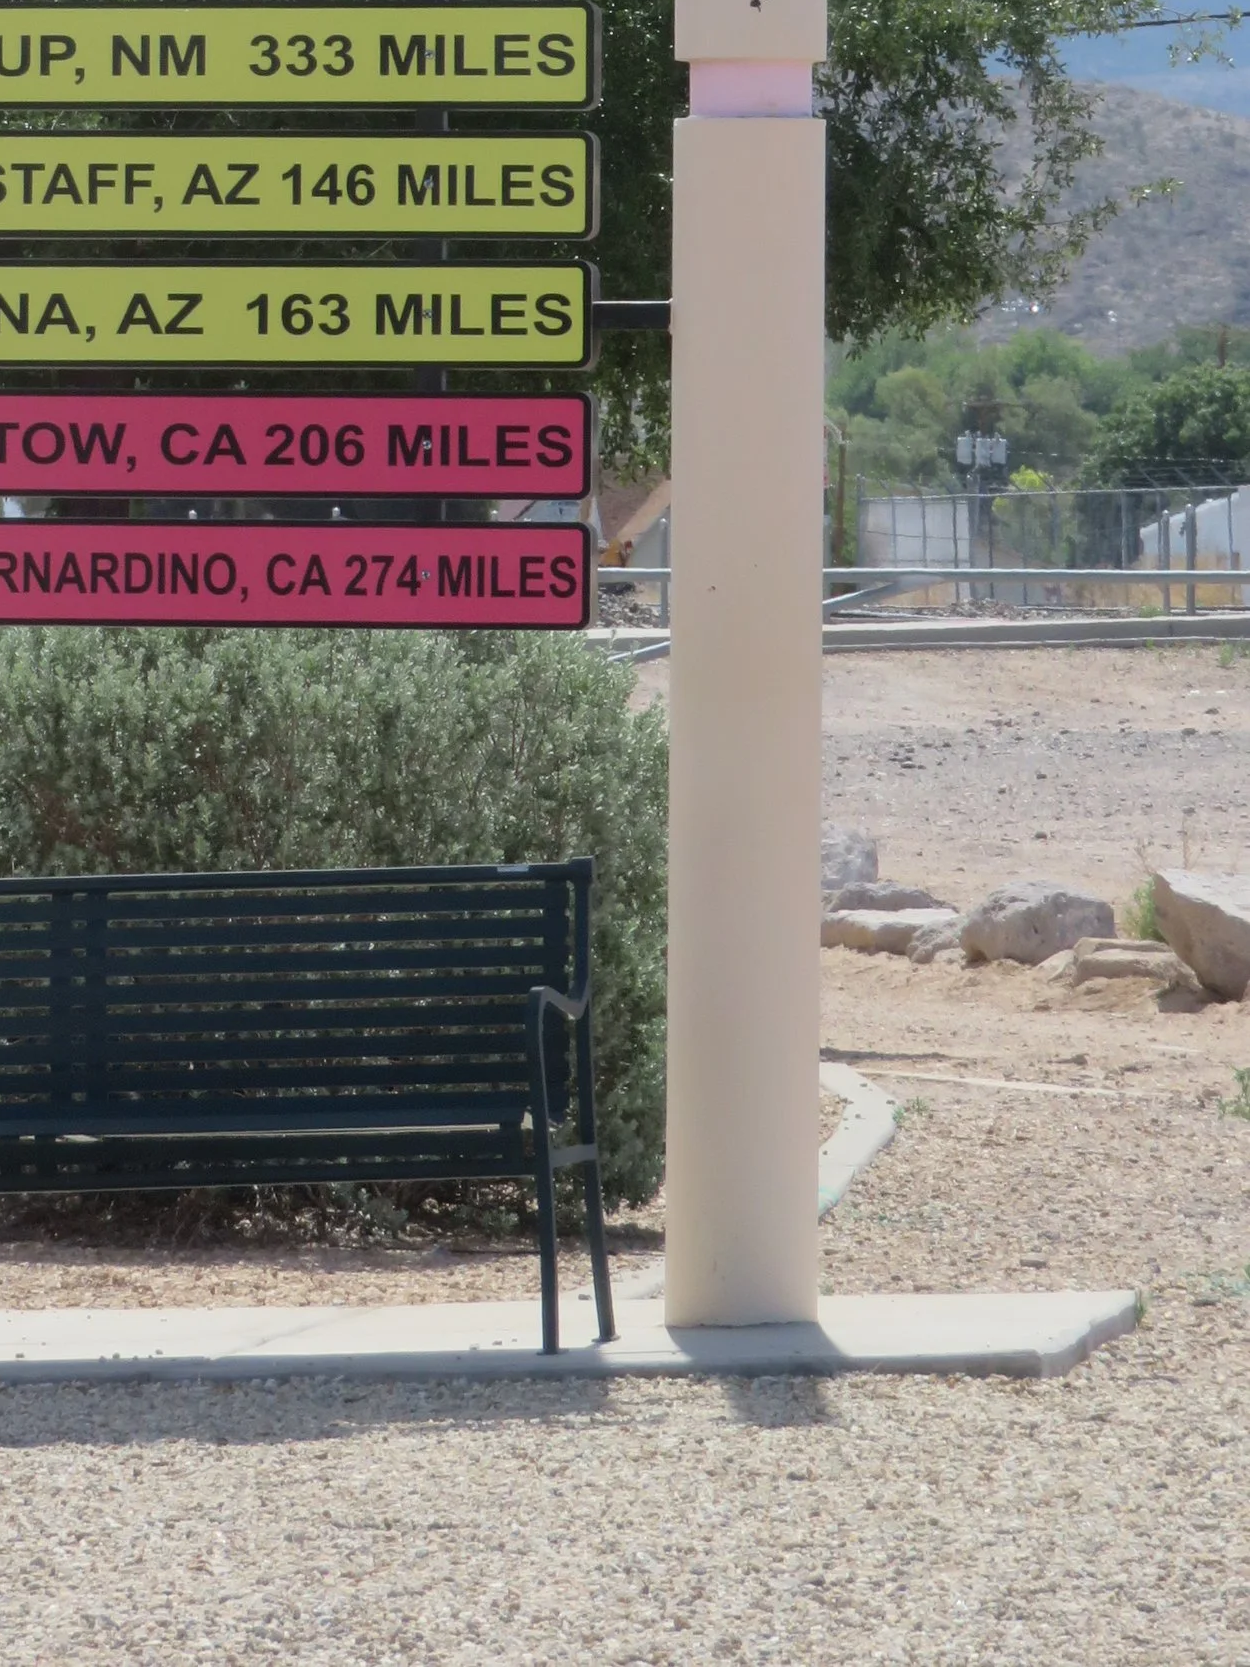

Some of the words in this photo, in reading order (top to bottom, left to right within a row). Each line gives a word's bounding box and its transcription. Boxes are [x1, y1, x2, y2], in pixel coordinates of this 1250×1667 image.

[112, 35, 205, 76] NM
[250, 35, 354, 76] 333
[380, 34, 575, 76] MILES
[182, 164, 260, 205] AZ
[282, 164, 375, 206] 146
[398, 164, 574, 206] MILES
[117, 294, 203, 334] AZ
[247, 294, 350, 335] 163
[376, 294, 572, 336] MILES
[161, 423, 246, 465] CA
[264, 424, 365, 466] 206
[388, 424, 572, 467] MILES
[267, 554, 331, 595] CA
[345, 555, 421, 596] 274
[438, 555, 577, 598] MILES
